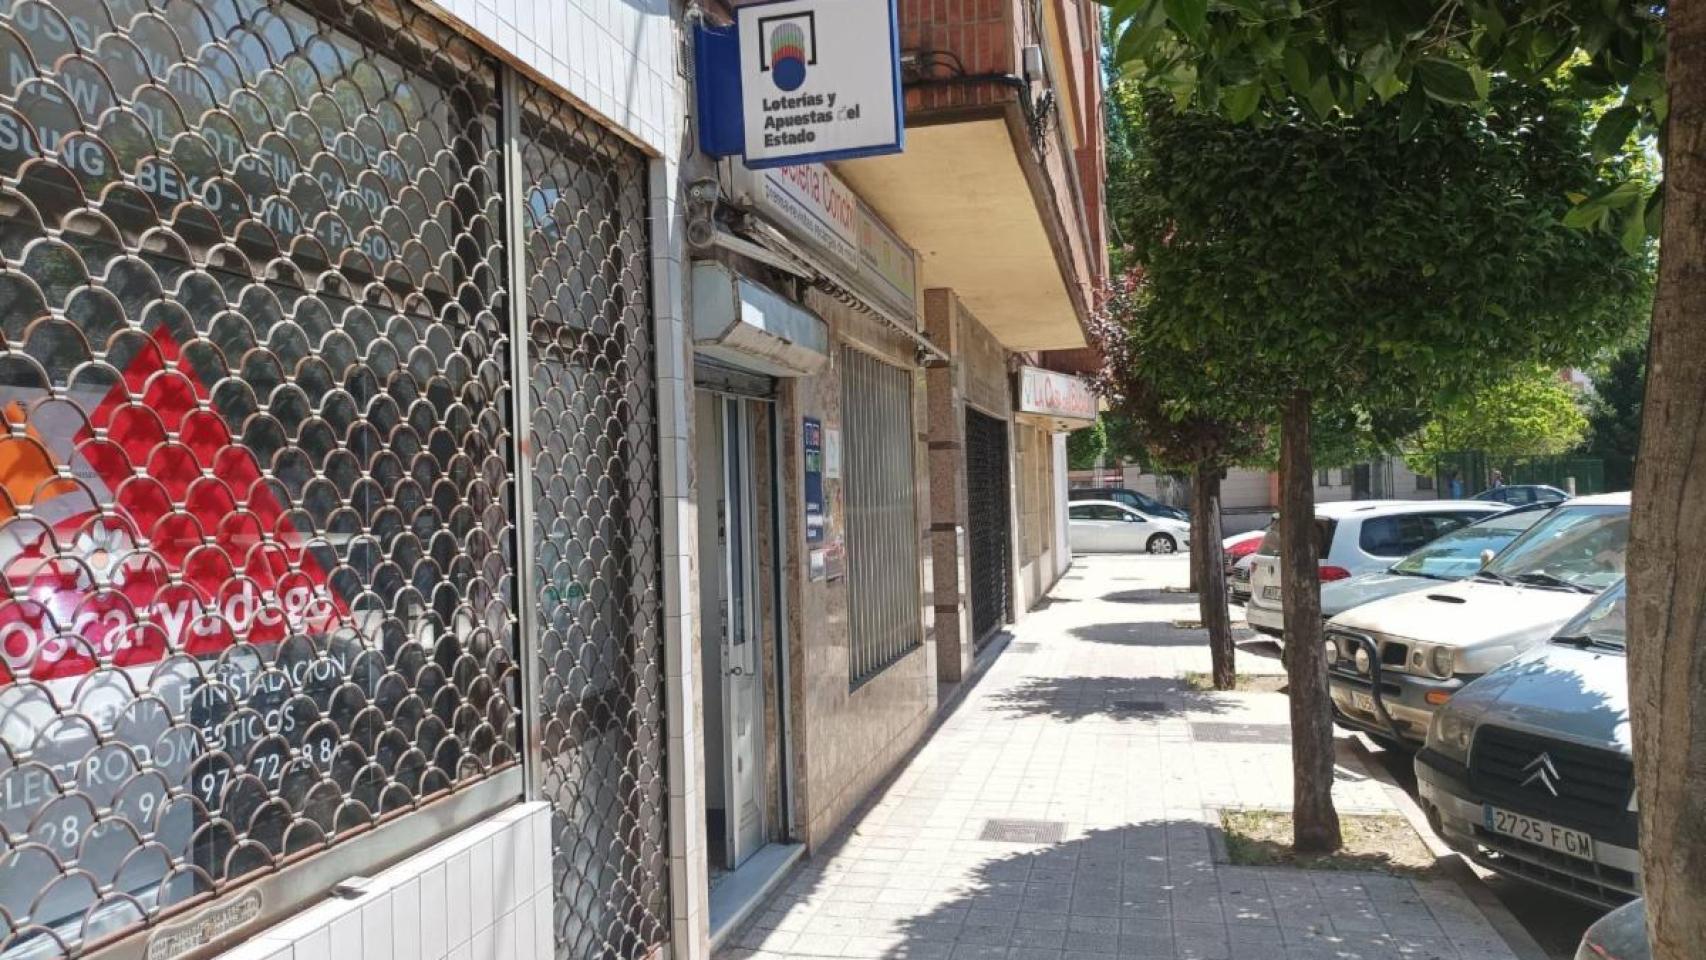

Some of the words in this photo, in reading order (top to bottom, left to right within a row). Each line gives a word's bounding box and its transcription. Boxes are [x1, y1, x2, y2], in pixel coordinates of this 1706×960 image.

[763, 91, 823, 111] Loterías
[827, 92, 836, 108] y
[764, 112, 833, 131] Apuestas
[764, 129, 816, 147] Estado
[1496, 811, 1544, 843] 2725
[1550, 827, 1591, 857] FGM
